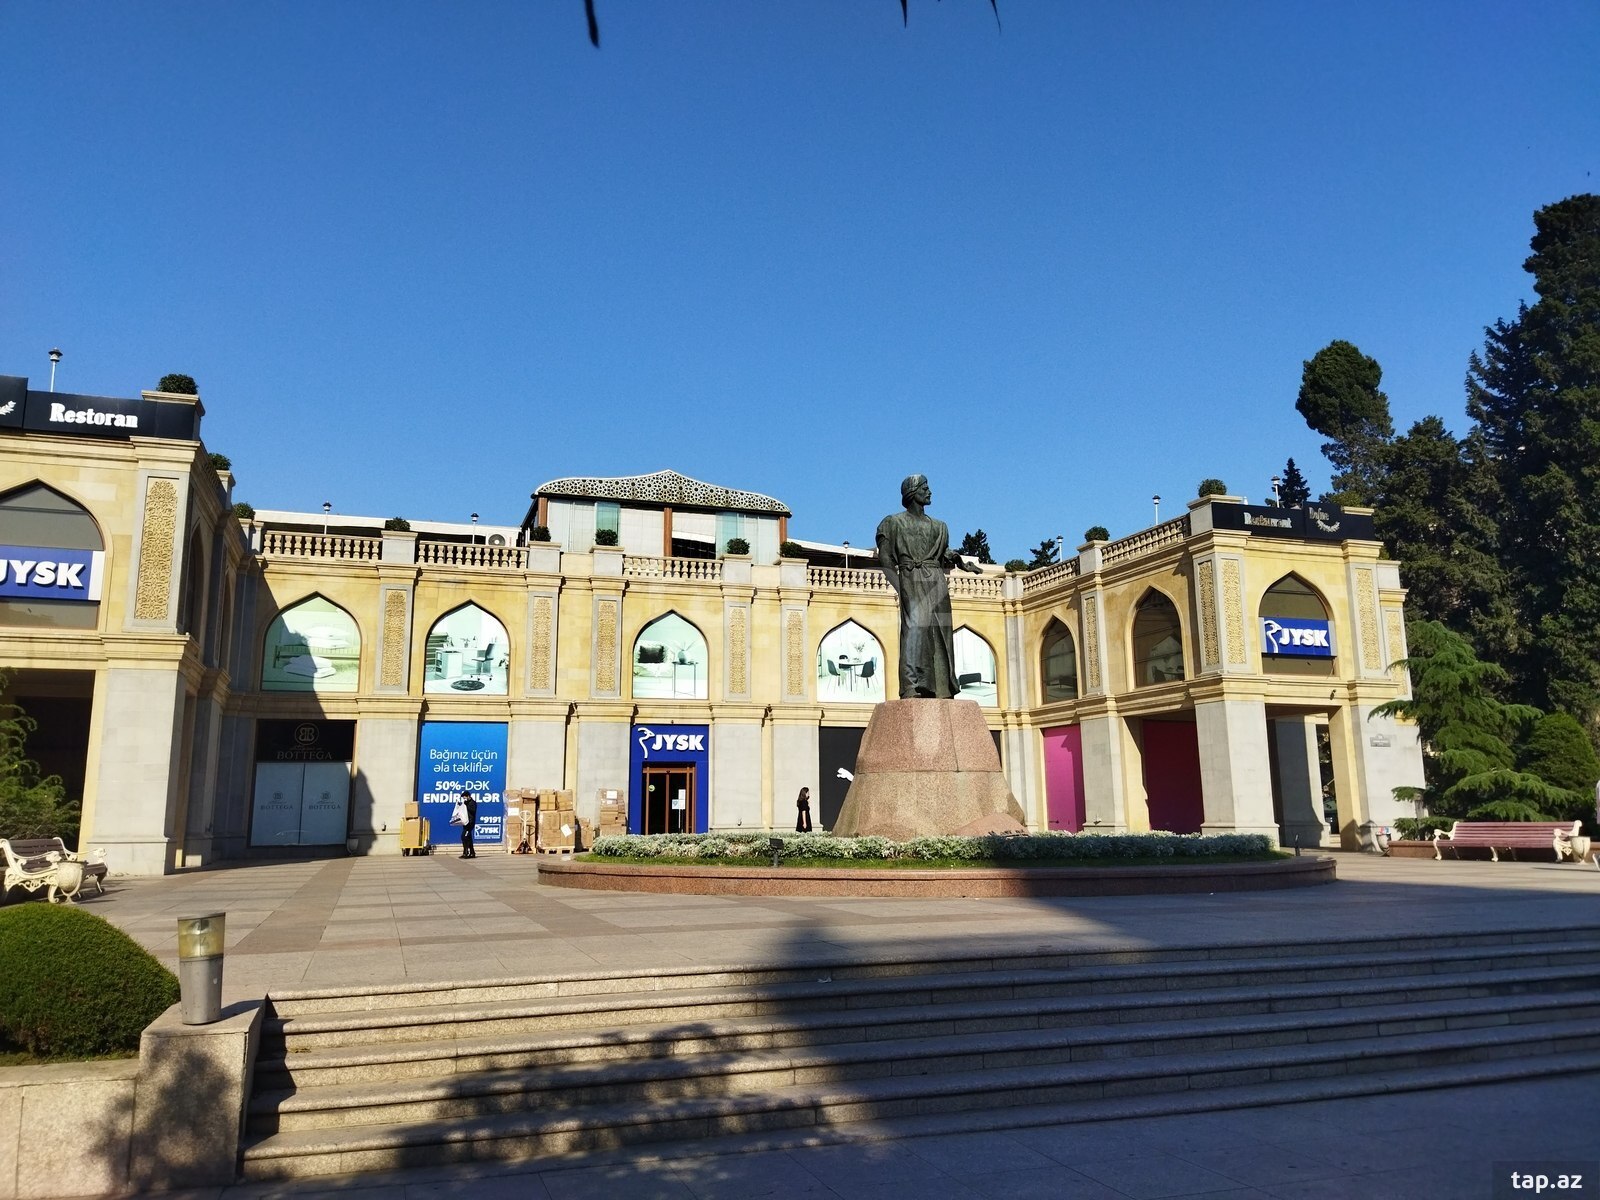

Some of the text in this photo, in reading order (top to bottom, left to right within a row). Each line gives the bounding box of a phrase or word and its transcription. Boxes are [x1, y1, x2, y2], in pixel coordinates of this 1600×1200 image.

[50, 403, 138, 428] Restoran
[1279, 627, 1330, 647] JYSK
[652, 734, 705, 751] JYSK
[277, 750, 332, 760] BOTTEGA
[430, 748, 498, 761] Bağınız üçün
[433, 762, 493, 773] əla təkliflər
[435, 780, 490, 791] 50%-DƏK
